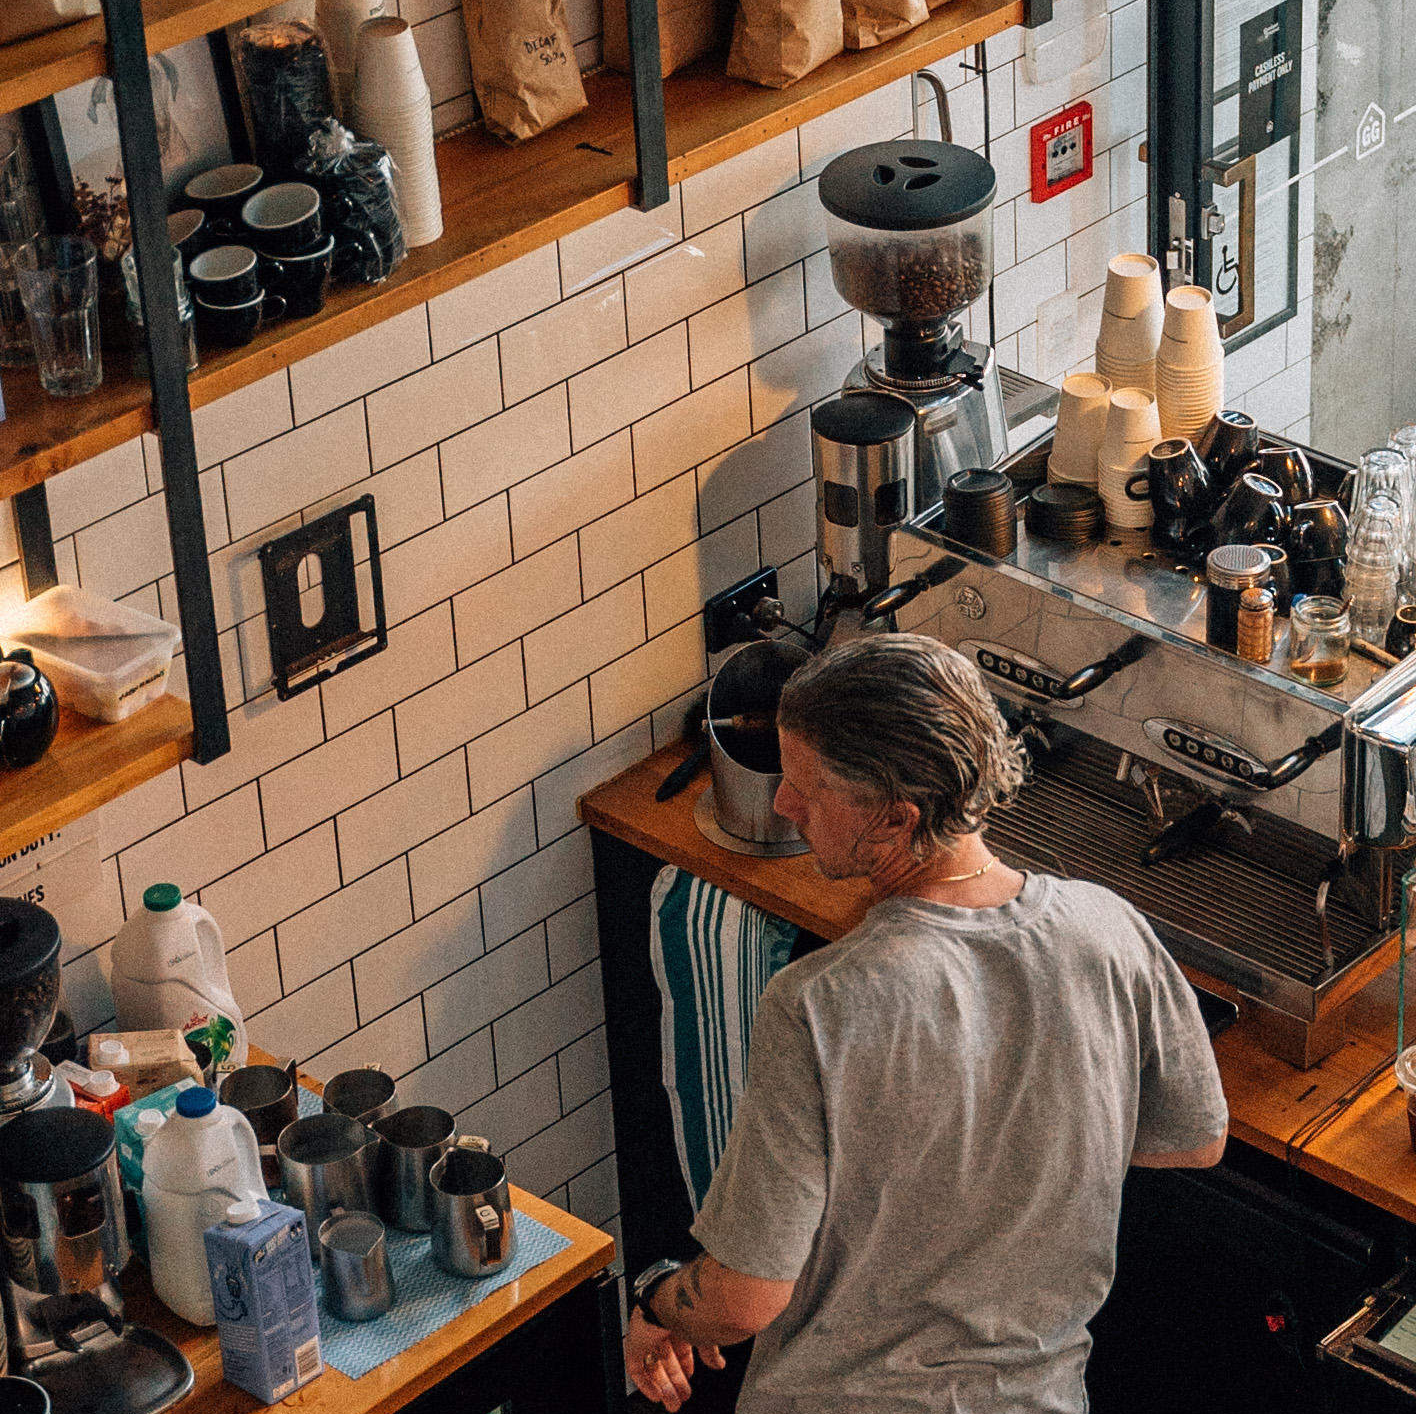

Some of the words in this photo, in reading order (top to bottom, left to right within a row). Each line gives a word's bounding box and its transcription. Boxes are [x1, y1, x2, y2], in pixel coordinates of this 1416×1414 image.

[1248, 68, 1277, 94] PAYMENT
[1277, 59, 1293, 78] ONLY
[1254, 51, 1286, 78] CASHLESS
[1053, 115, 1080, 136] FIRE
